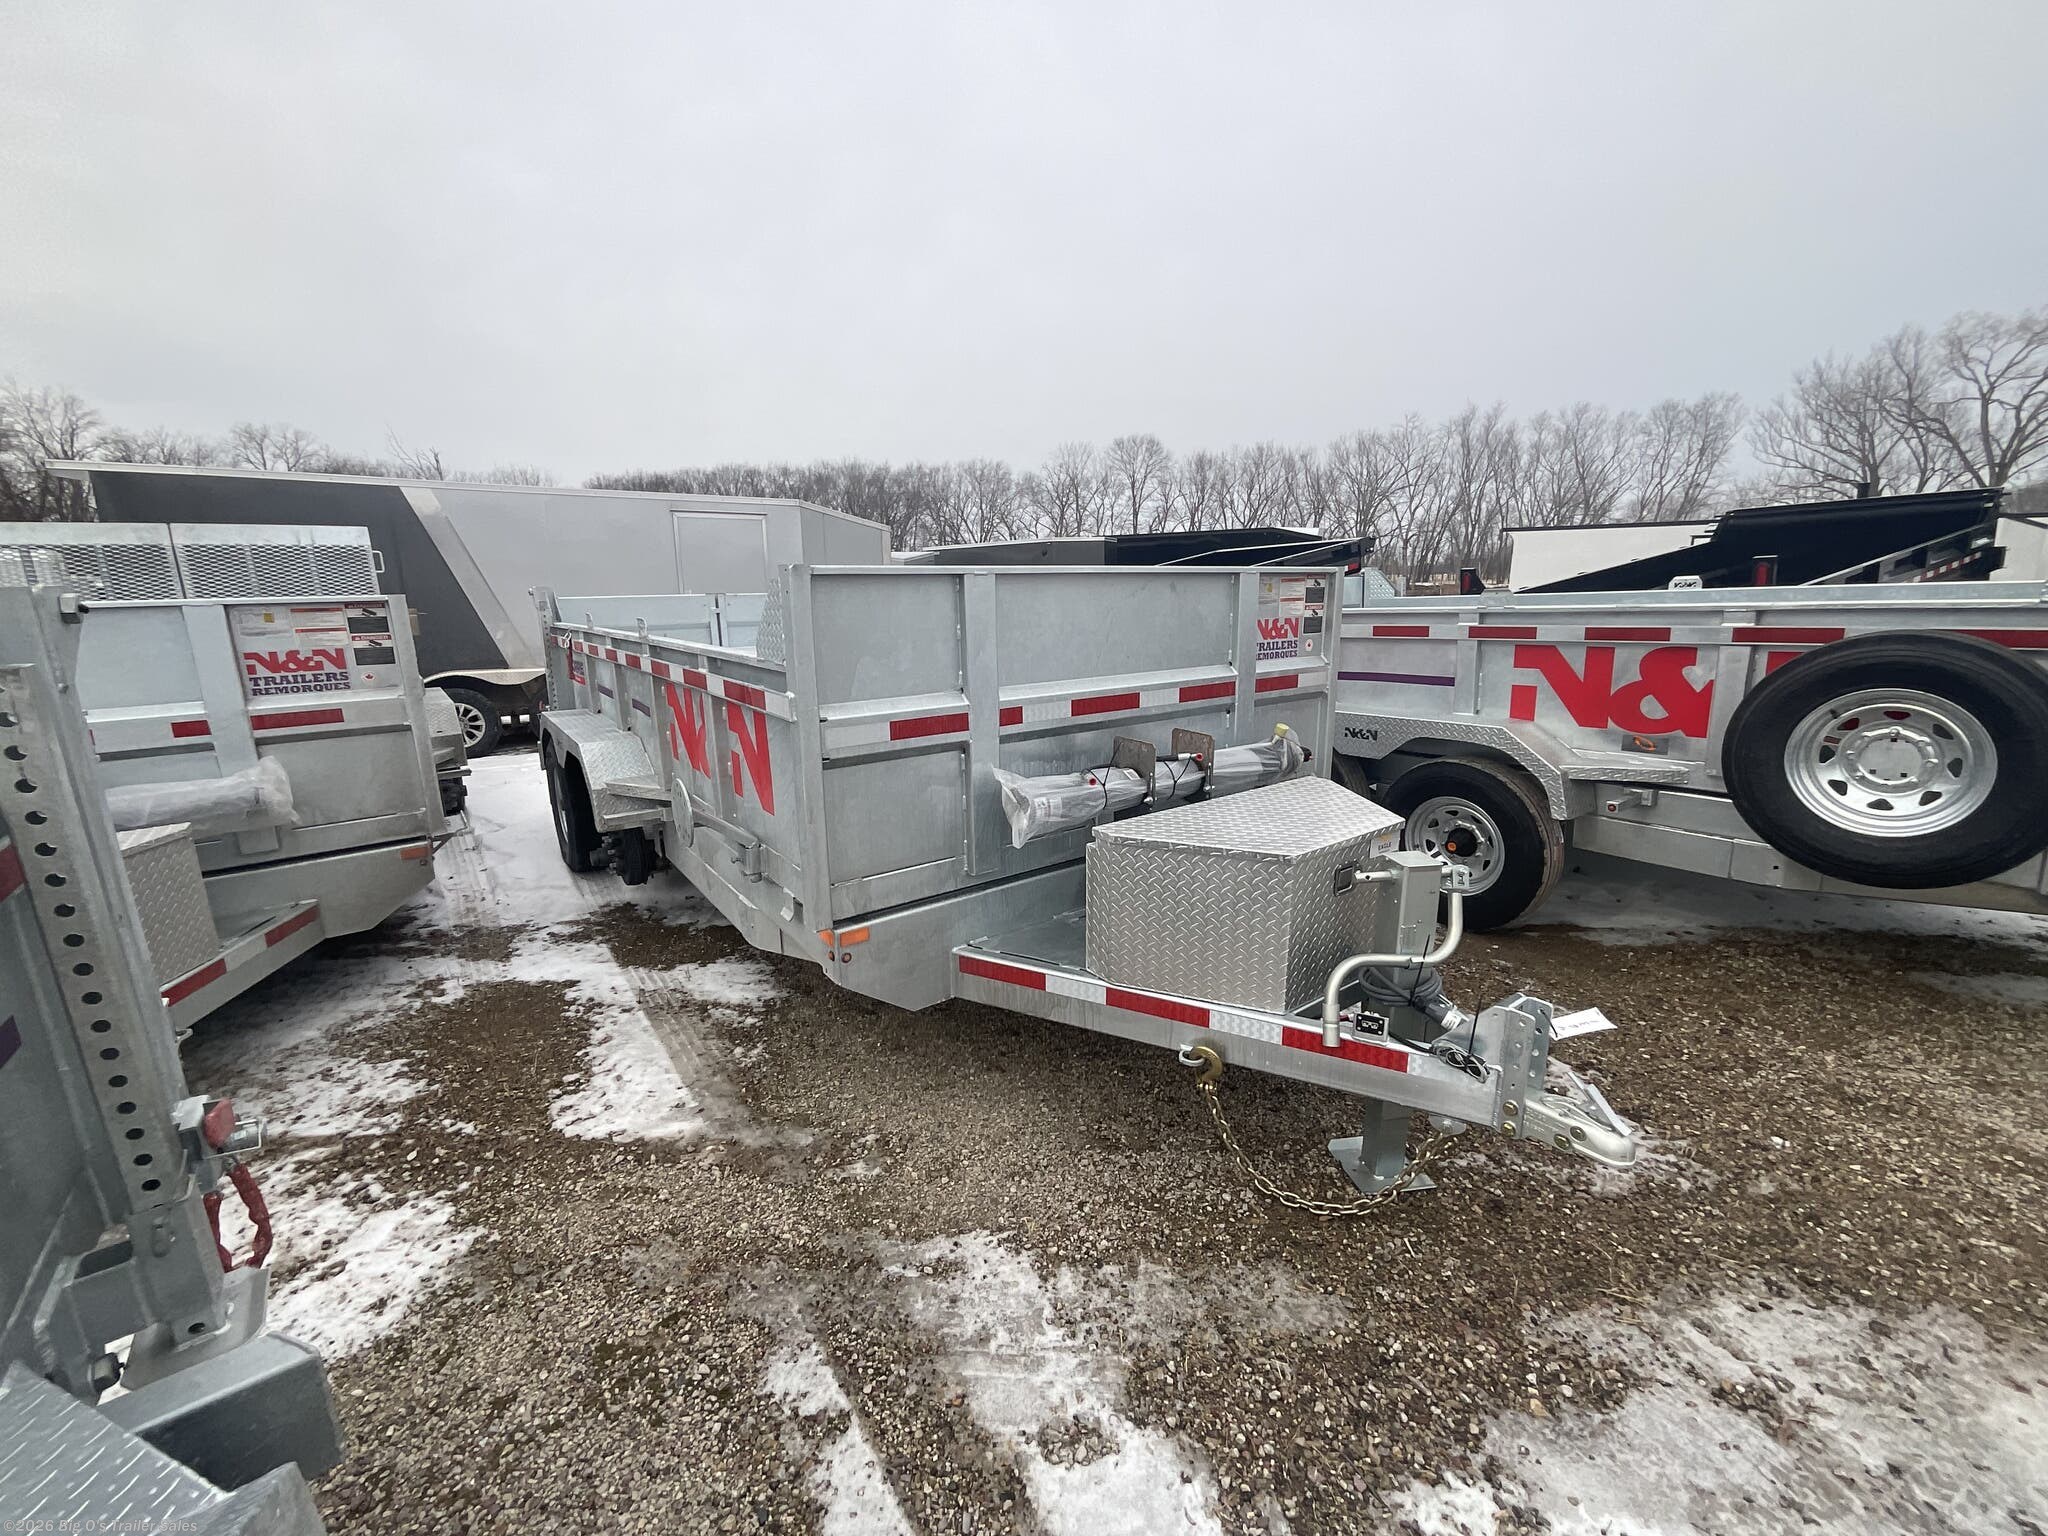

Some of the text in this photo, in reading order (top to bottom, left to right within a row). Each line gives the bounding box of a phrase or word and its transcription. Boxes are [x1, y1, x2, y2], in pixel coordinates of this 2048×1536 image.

[1257, 640, 1298, 651] RAILERS
[243, 648, 347, 675] N&N
[1256, 650, 1298, 660] EMORQUES
[249, 671, 349, 687] TRAILERS
[252, 681, 350, 696] REMORQUES
[1344, 727, 1378, 741] N&N
